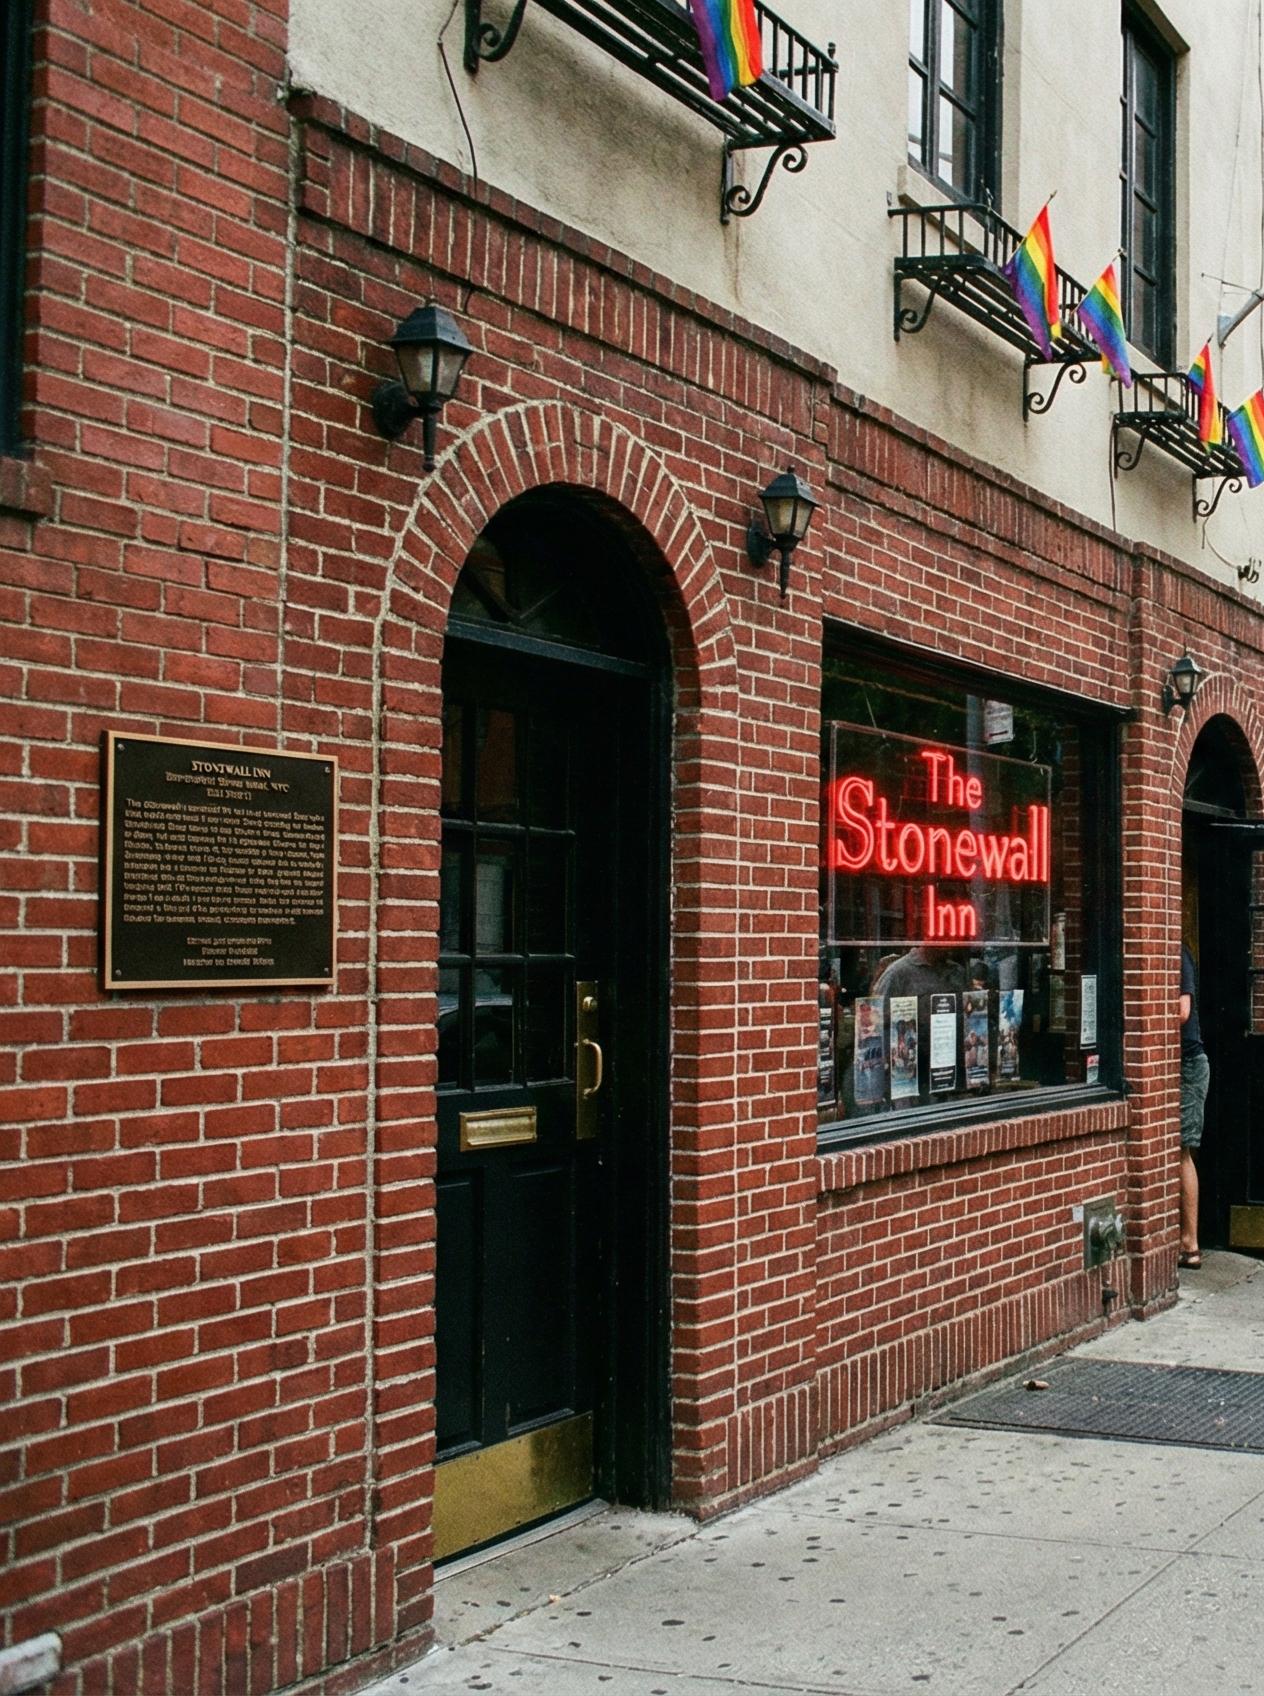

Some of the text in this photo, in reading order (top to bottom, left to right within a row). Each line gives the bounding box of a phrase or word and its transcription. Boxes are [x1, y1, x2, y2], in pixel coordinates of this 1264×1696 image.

[921, 751, 983, 809] The
[837, 775, 1049, 882] Stonewall
[927, 884, 977, 937] Inn
